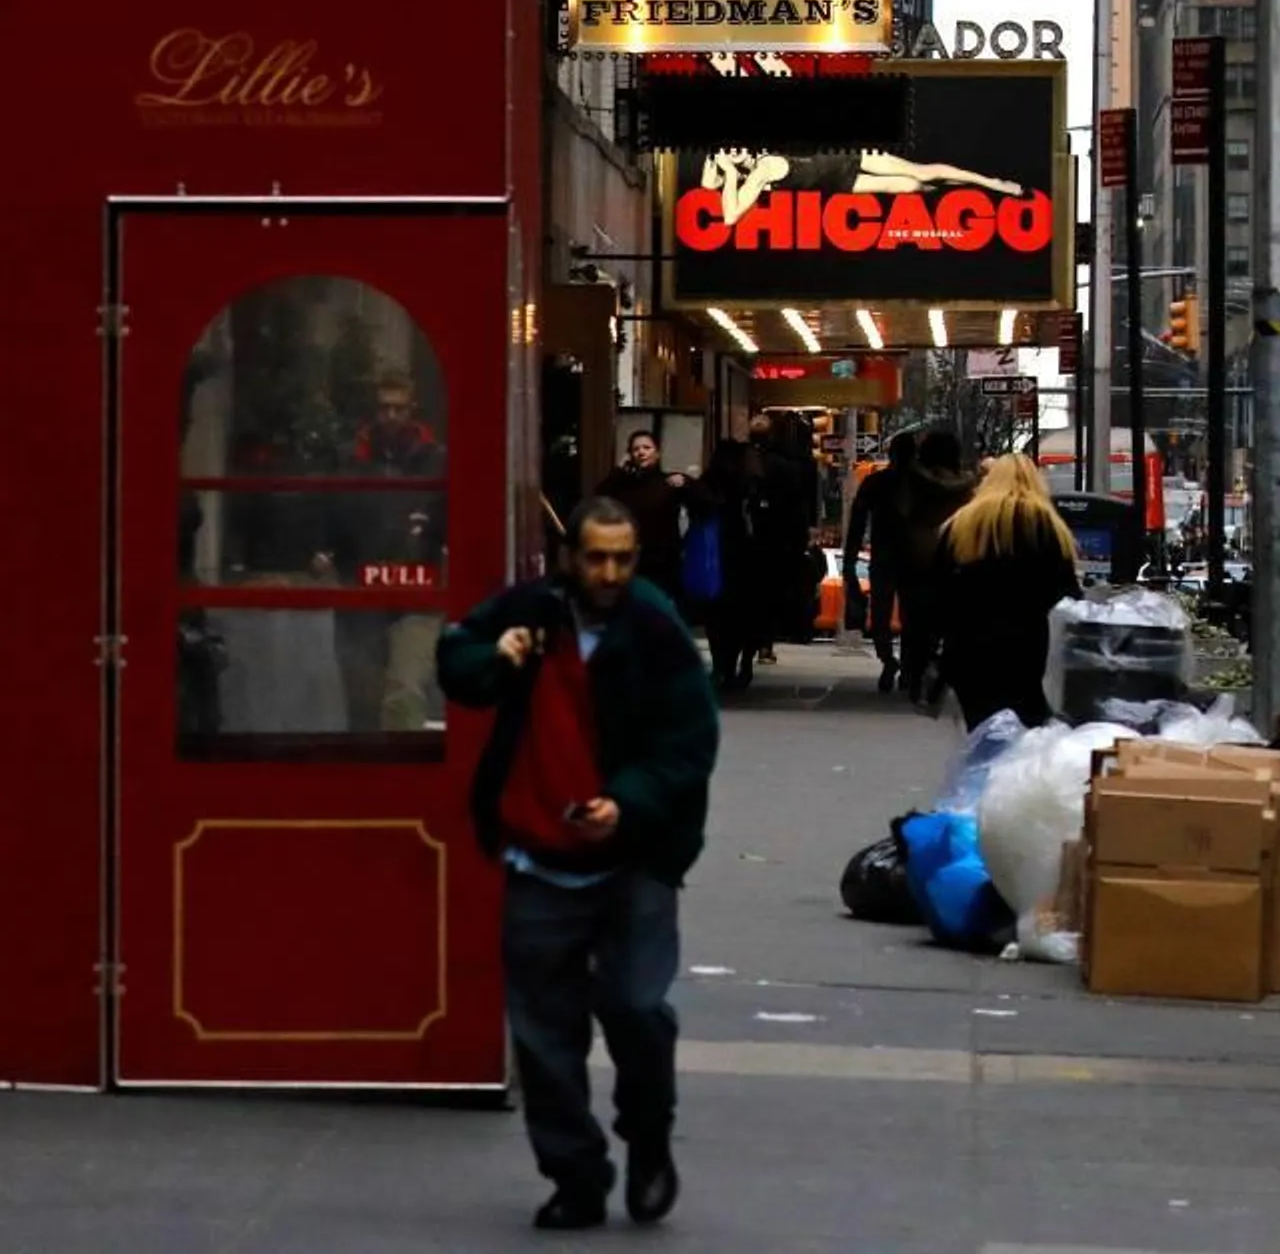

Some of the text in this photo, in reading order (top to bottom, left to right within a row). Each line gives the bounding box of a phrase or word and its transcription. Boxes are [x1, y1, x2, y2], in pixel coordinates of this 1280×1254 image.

[134, 27, 384, 108] Lillie's
[675, 188, 1054, 253] CHICAGO
[364, 566, 433, 586] PULL
